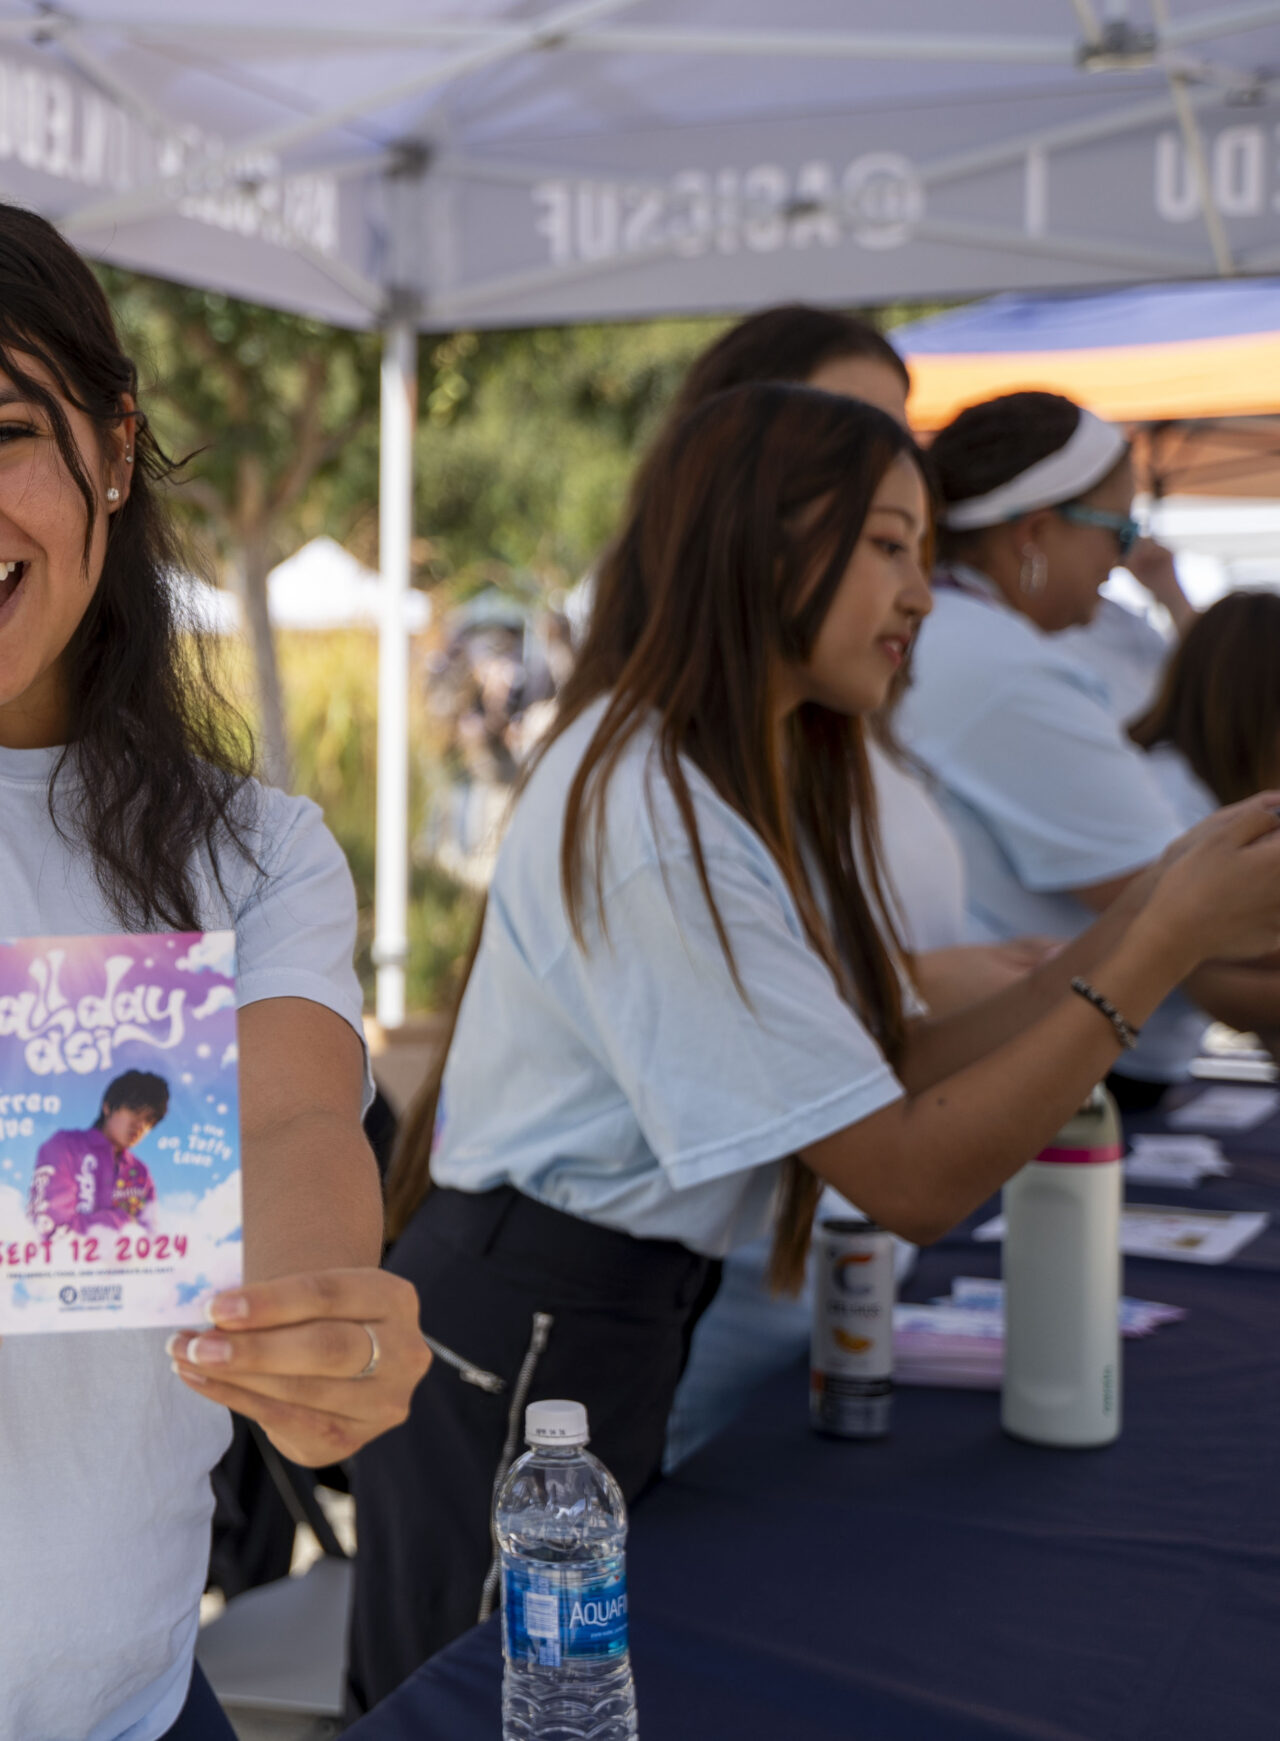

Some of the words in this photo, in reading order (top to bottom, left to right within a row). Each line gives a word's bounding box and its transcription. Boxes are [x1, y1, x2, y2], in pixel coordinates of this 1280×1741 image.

[77, 955, 186, 1049] day
[24, 1027, 114, 1075] asi
[70, 1238, 100, 1263] 12
[115, 1234, 189, 1262] 2024
